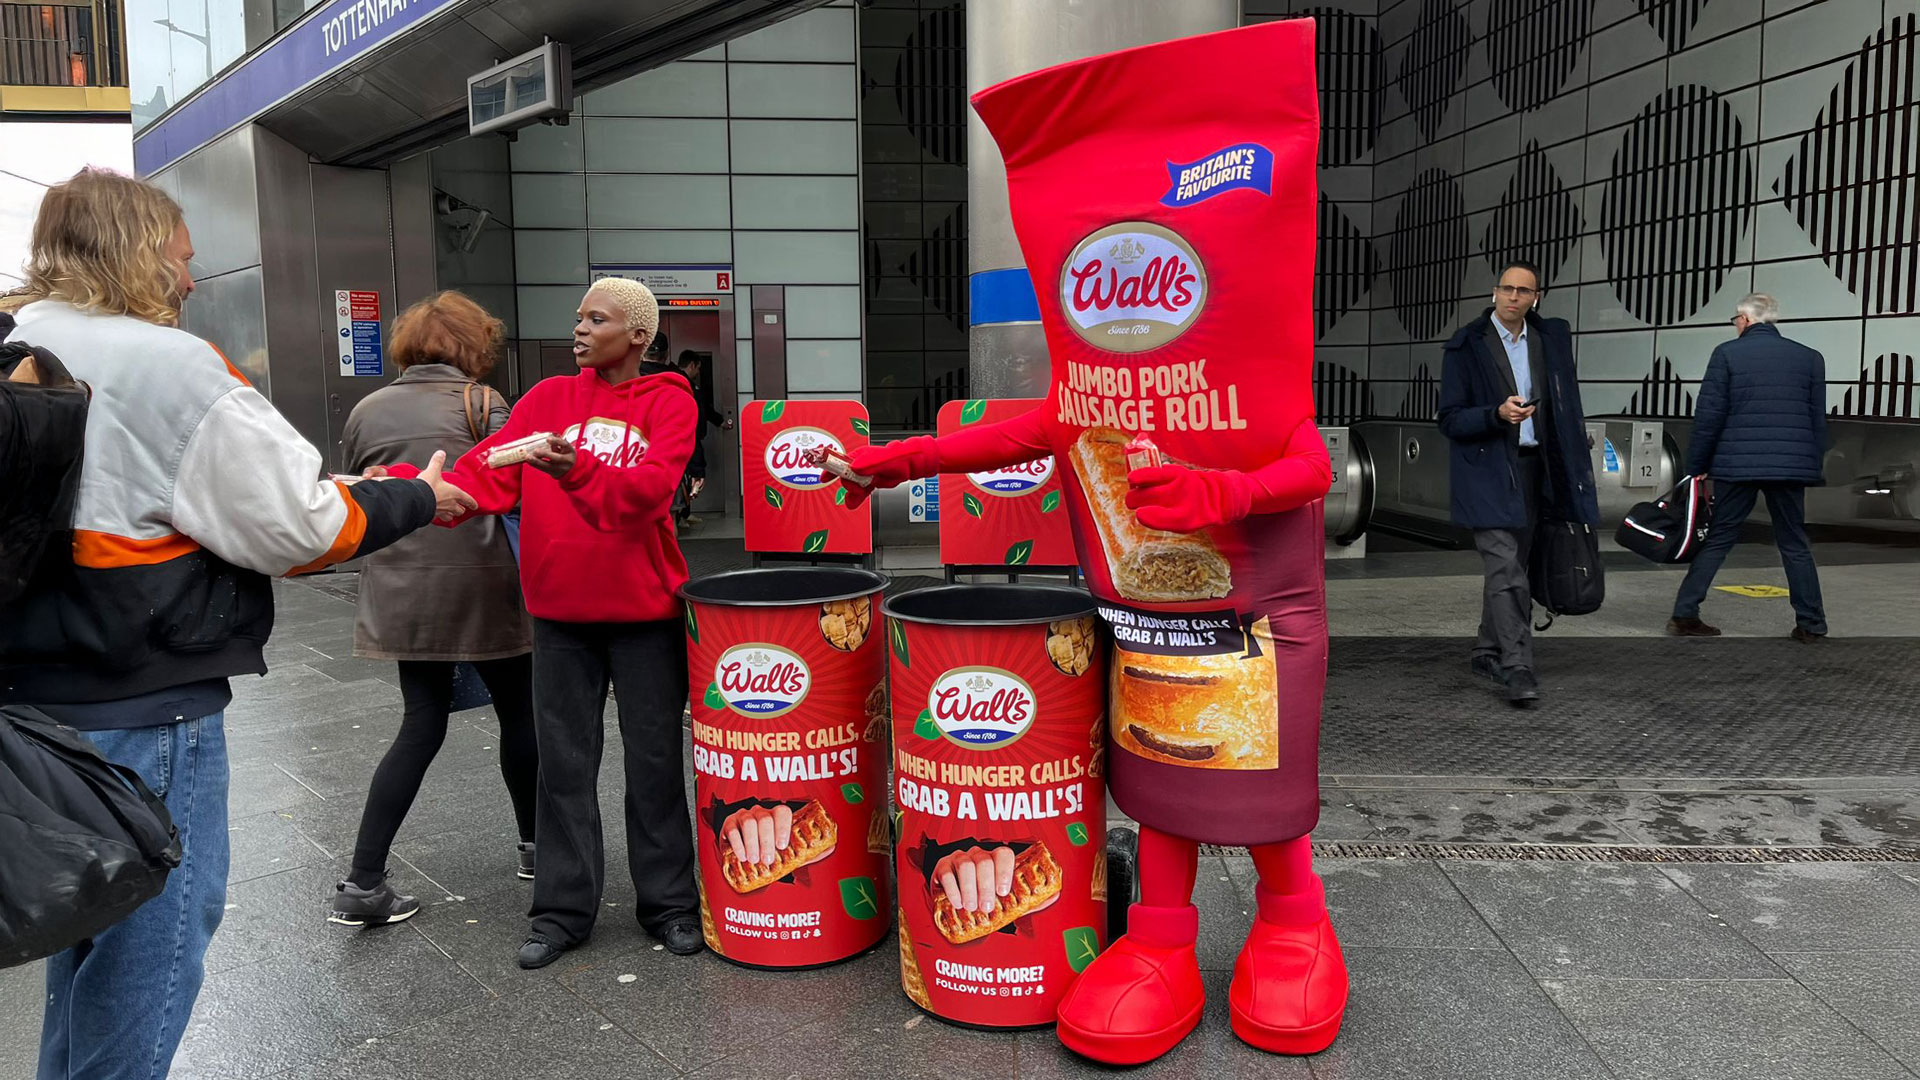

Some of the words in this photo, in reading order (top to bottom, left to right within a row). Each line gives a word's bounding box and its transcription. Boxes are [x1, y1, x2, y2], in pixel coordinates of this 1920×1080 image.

[1179, 148, 1256, 186] BRITAIN'S
[1176, 165, 1252, 201] FAVOURITE
[719, 279, 728, 288] A
[1071, 255, 1196, 312] Wall's
[1107, 325, 1130, 335] Since
[1131, 324, 1150, 335] 1786
[1067, 360, 1133, 398] JUMBO
[1138, 358, 1208, 398] PORK
[1057, 380, 1156, 431] SAUSAGE
[1165, 384, 1247, 431] ROLL
[1331, 471, 1338, 483] 3
[1640, 465, 1652, 477] 12
[1098, 606, 1135, 626] WHEN
[1137, 614, 1189, 631] HUNGER
[1191, 619, 1231, 629] CALLS
[1113, 625, 1151, 644] GRAB
[1153, 631, 1165, 646] A
[1168, 631, 1217, 647] WALL'S
[720, 661, 805, 695] Wall's
[935, 686, 1031, 725] Wall's
[693, 718, 723, 748] WHEN
[726, 730, 801, 752] HUNGER
[805, 722, 859, 749] CALLS,
[963, 732, 981, 740] Since
[693, 744, 735, 779] GRAB
[740, 756, 759, 782] A
[764, 747, 858, 782] WALL'S!
[898, 748, 937, 781] WHEN
[941, 762, 1025, 787] HUNGER
[1029, 755, 1085, 785] CALLS,
[899, 777, 951, 817] GRAB
[957, 791, 978, 820] A
[984, 782, 1083, 821] WALL'S!
[725, 907, 775, 928] CRAVING
[777, 910, 821, 928] MORE?
[725, 924, 762, 938] FOLLOW
[764, 931, 778, 939] US
[935, 958, 994, 983] CRAVING
[996, 965, 1044, 984] MORE?
[935, 977, 979, 994] FOLLOW
[981, 986, 997, 996] US
